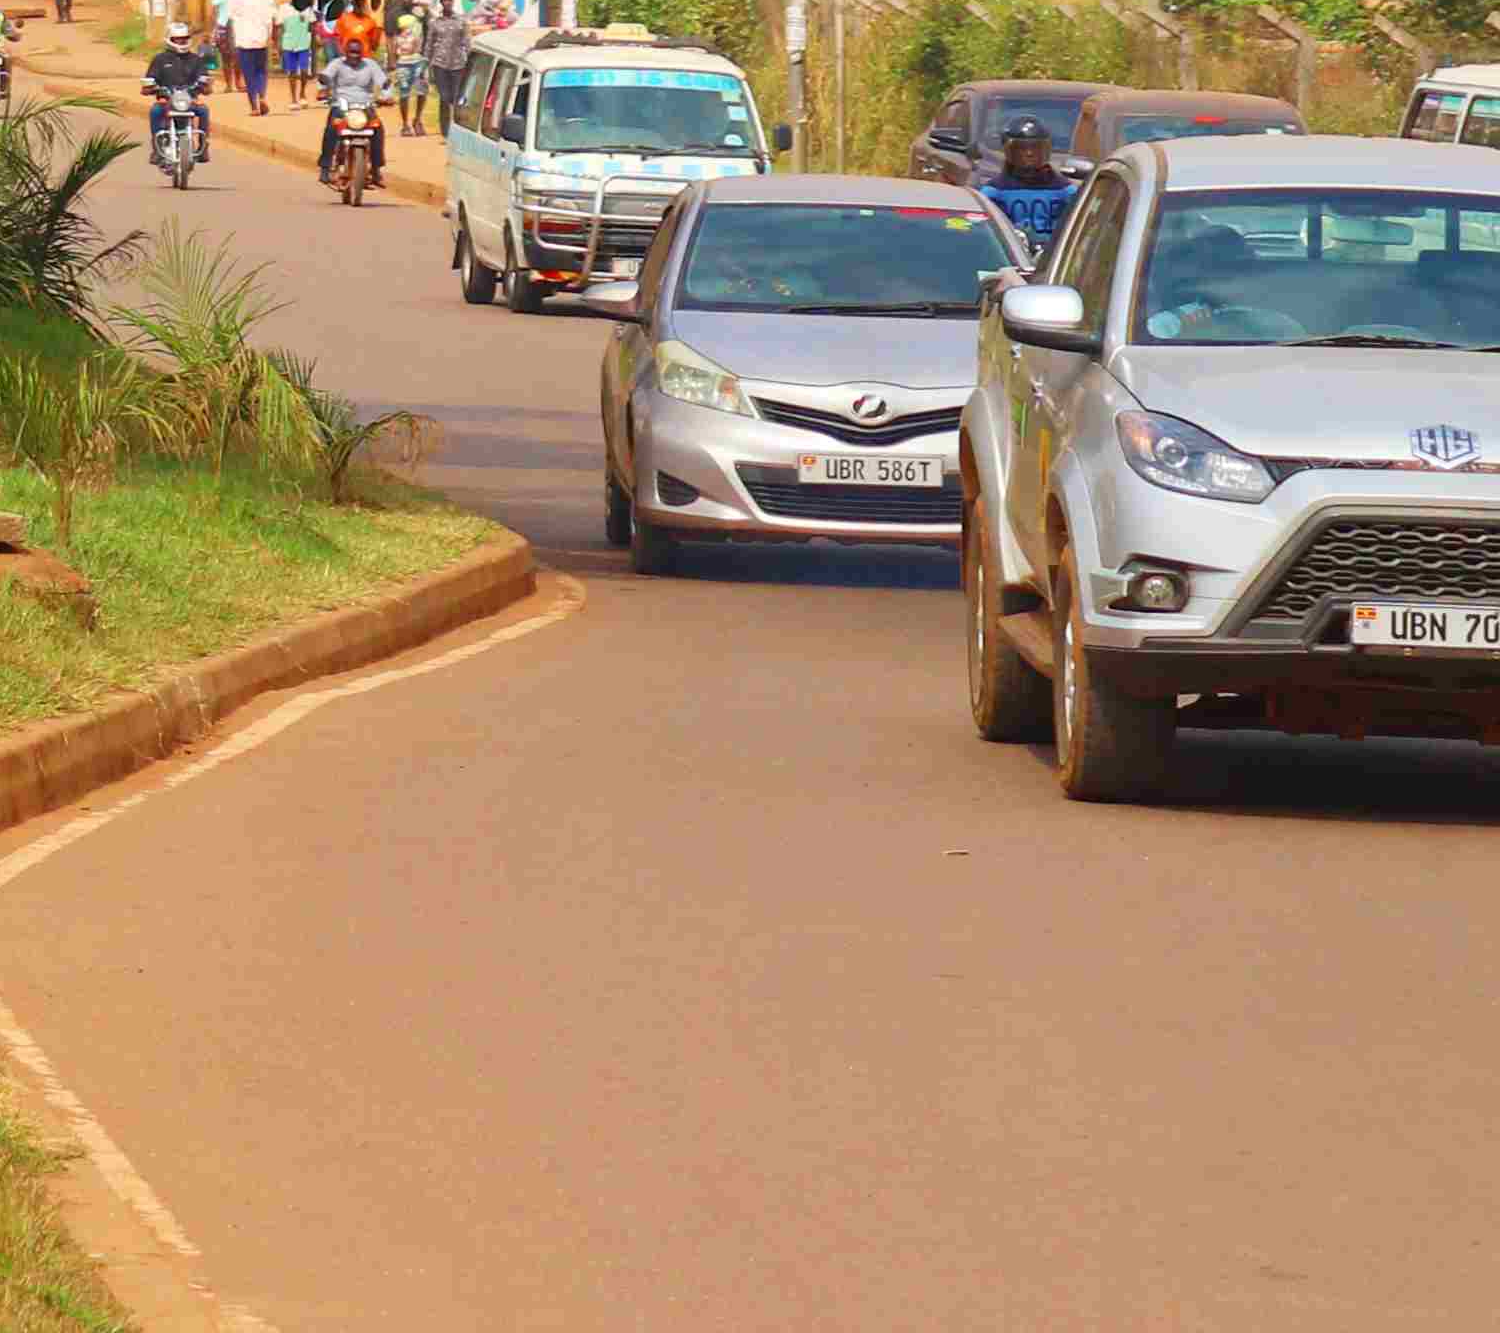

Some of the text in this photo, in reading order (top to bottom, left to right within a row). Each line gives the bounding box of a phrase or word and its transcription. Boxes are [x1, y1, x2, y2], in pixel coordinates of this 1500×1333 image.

[825, 458, 932, 482] UBR 586T
[1390, 610, 1447, 642] UBN
